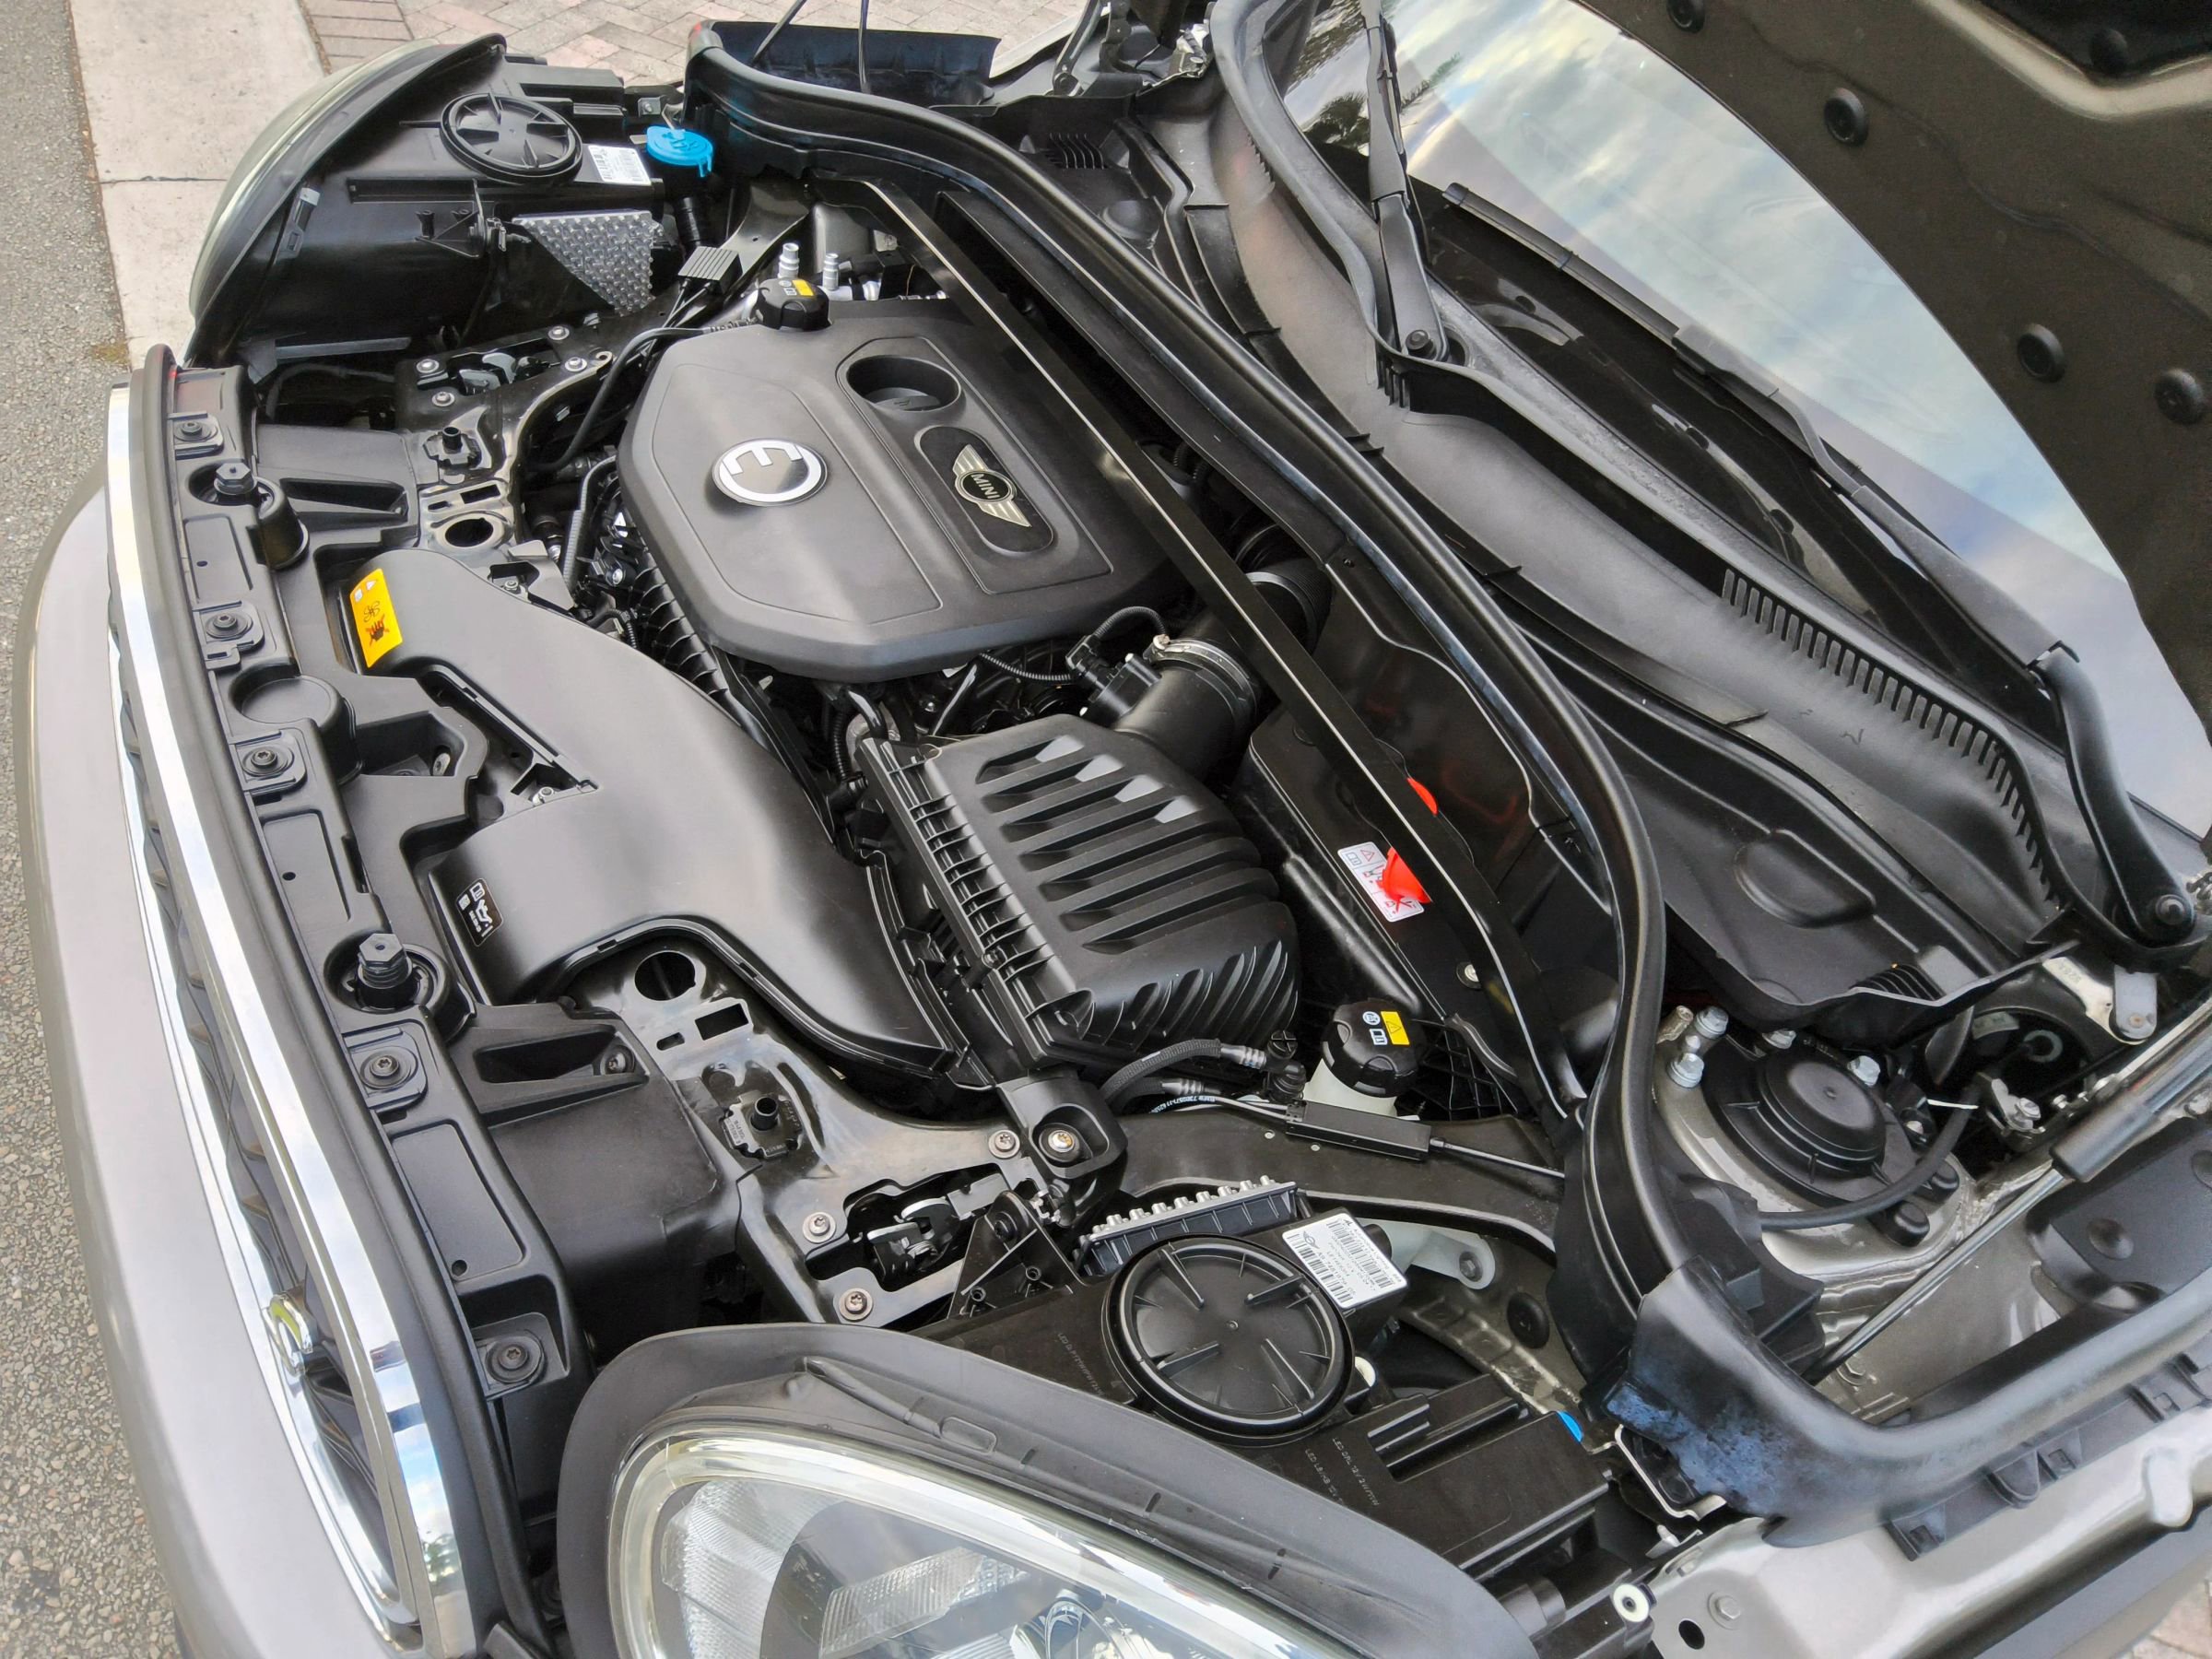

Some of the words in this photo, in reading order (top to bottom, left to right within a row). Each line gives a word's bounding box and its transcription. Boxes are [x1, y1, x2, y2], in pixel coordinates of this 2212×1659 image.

[971, 473, 1001, 500] MINI
[1333, 1437, 1345, 1452] LED
[1305, 1448, 1317, 1463] LED
